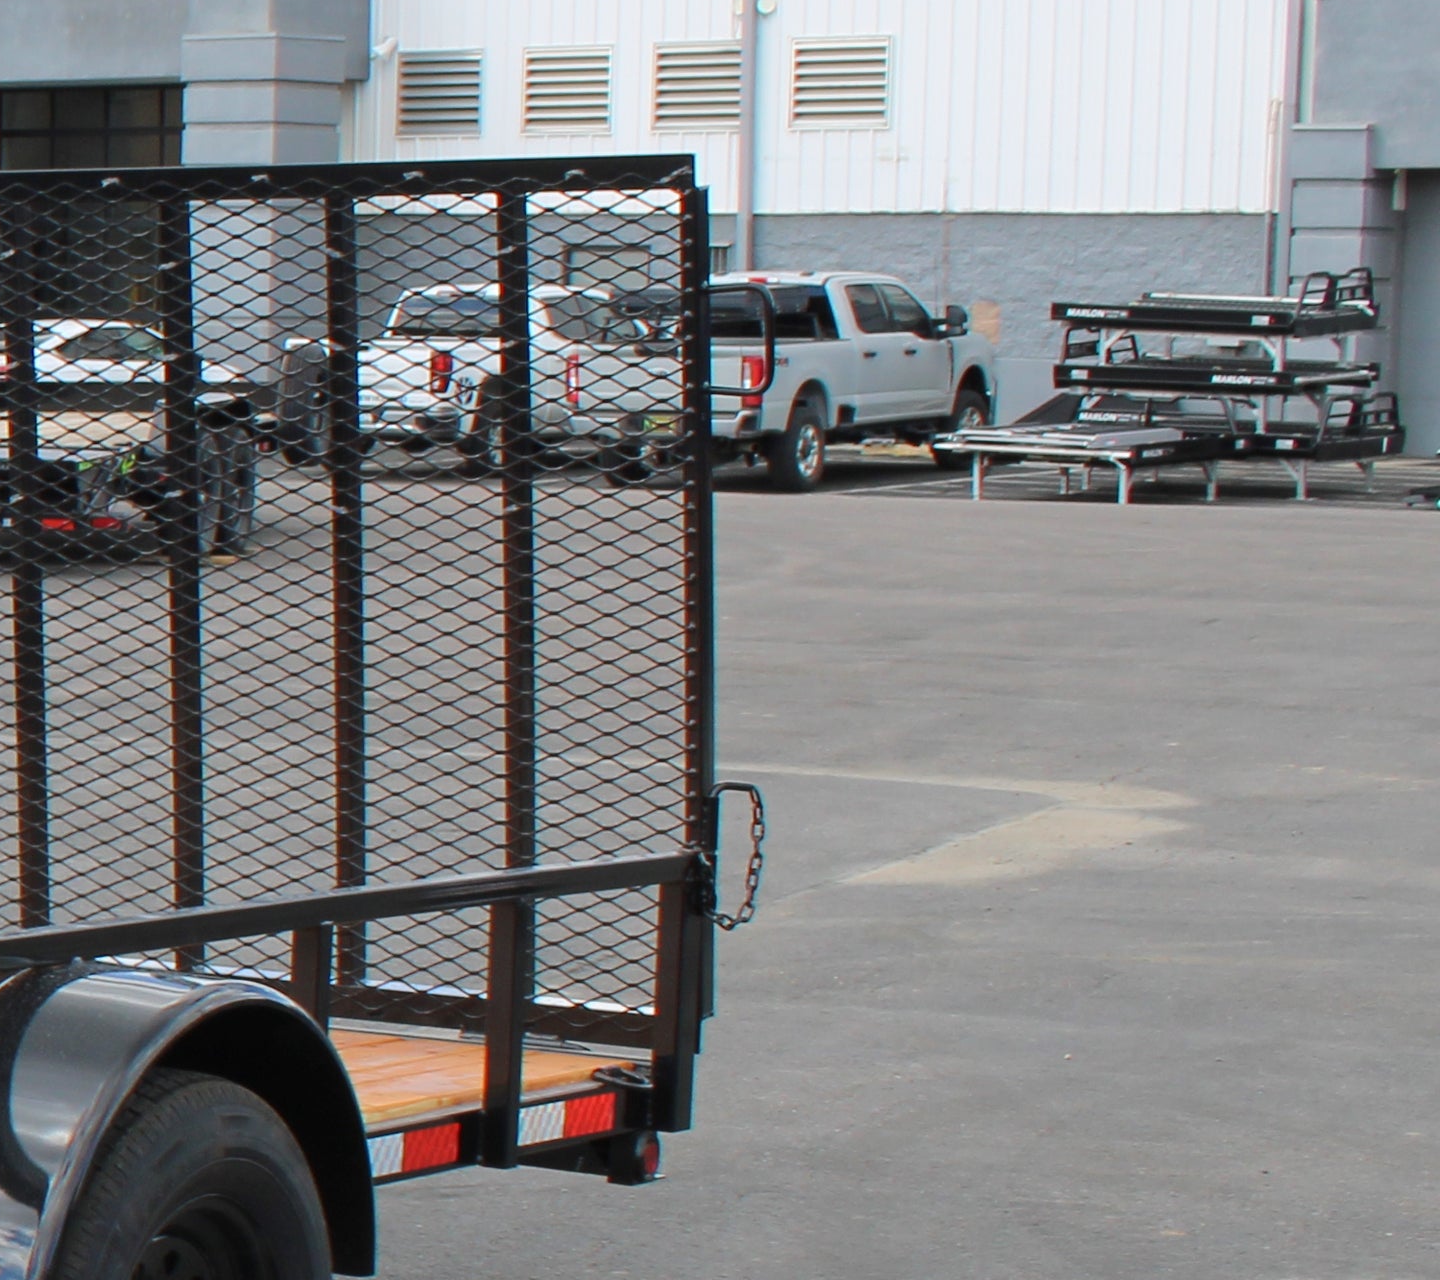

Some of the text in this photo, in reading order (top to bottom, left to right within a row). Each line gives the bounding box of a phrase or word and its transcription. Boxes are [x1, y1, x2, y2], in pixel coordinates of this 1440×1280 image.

[1066, 308, 1106, 318] MARLON
[1211, 374, 1252, 385] MARLON
[1079, 411, 1117, 422] MARLON
